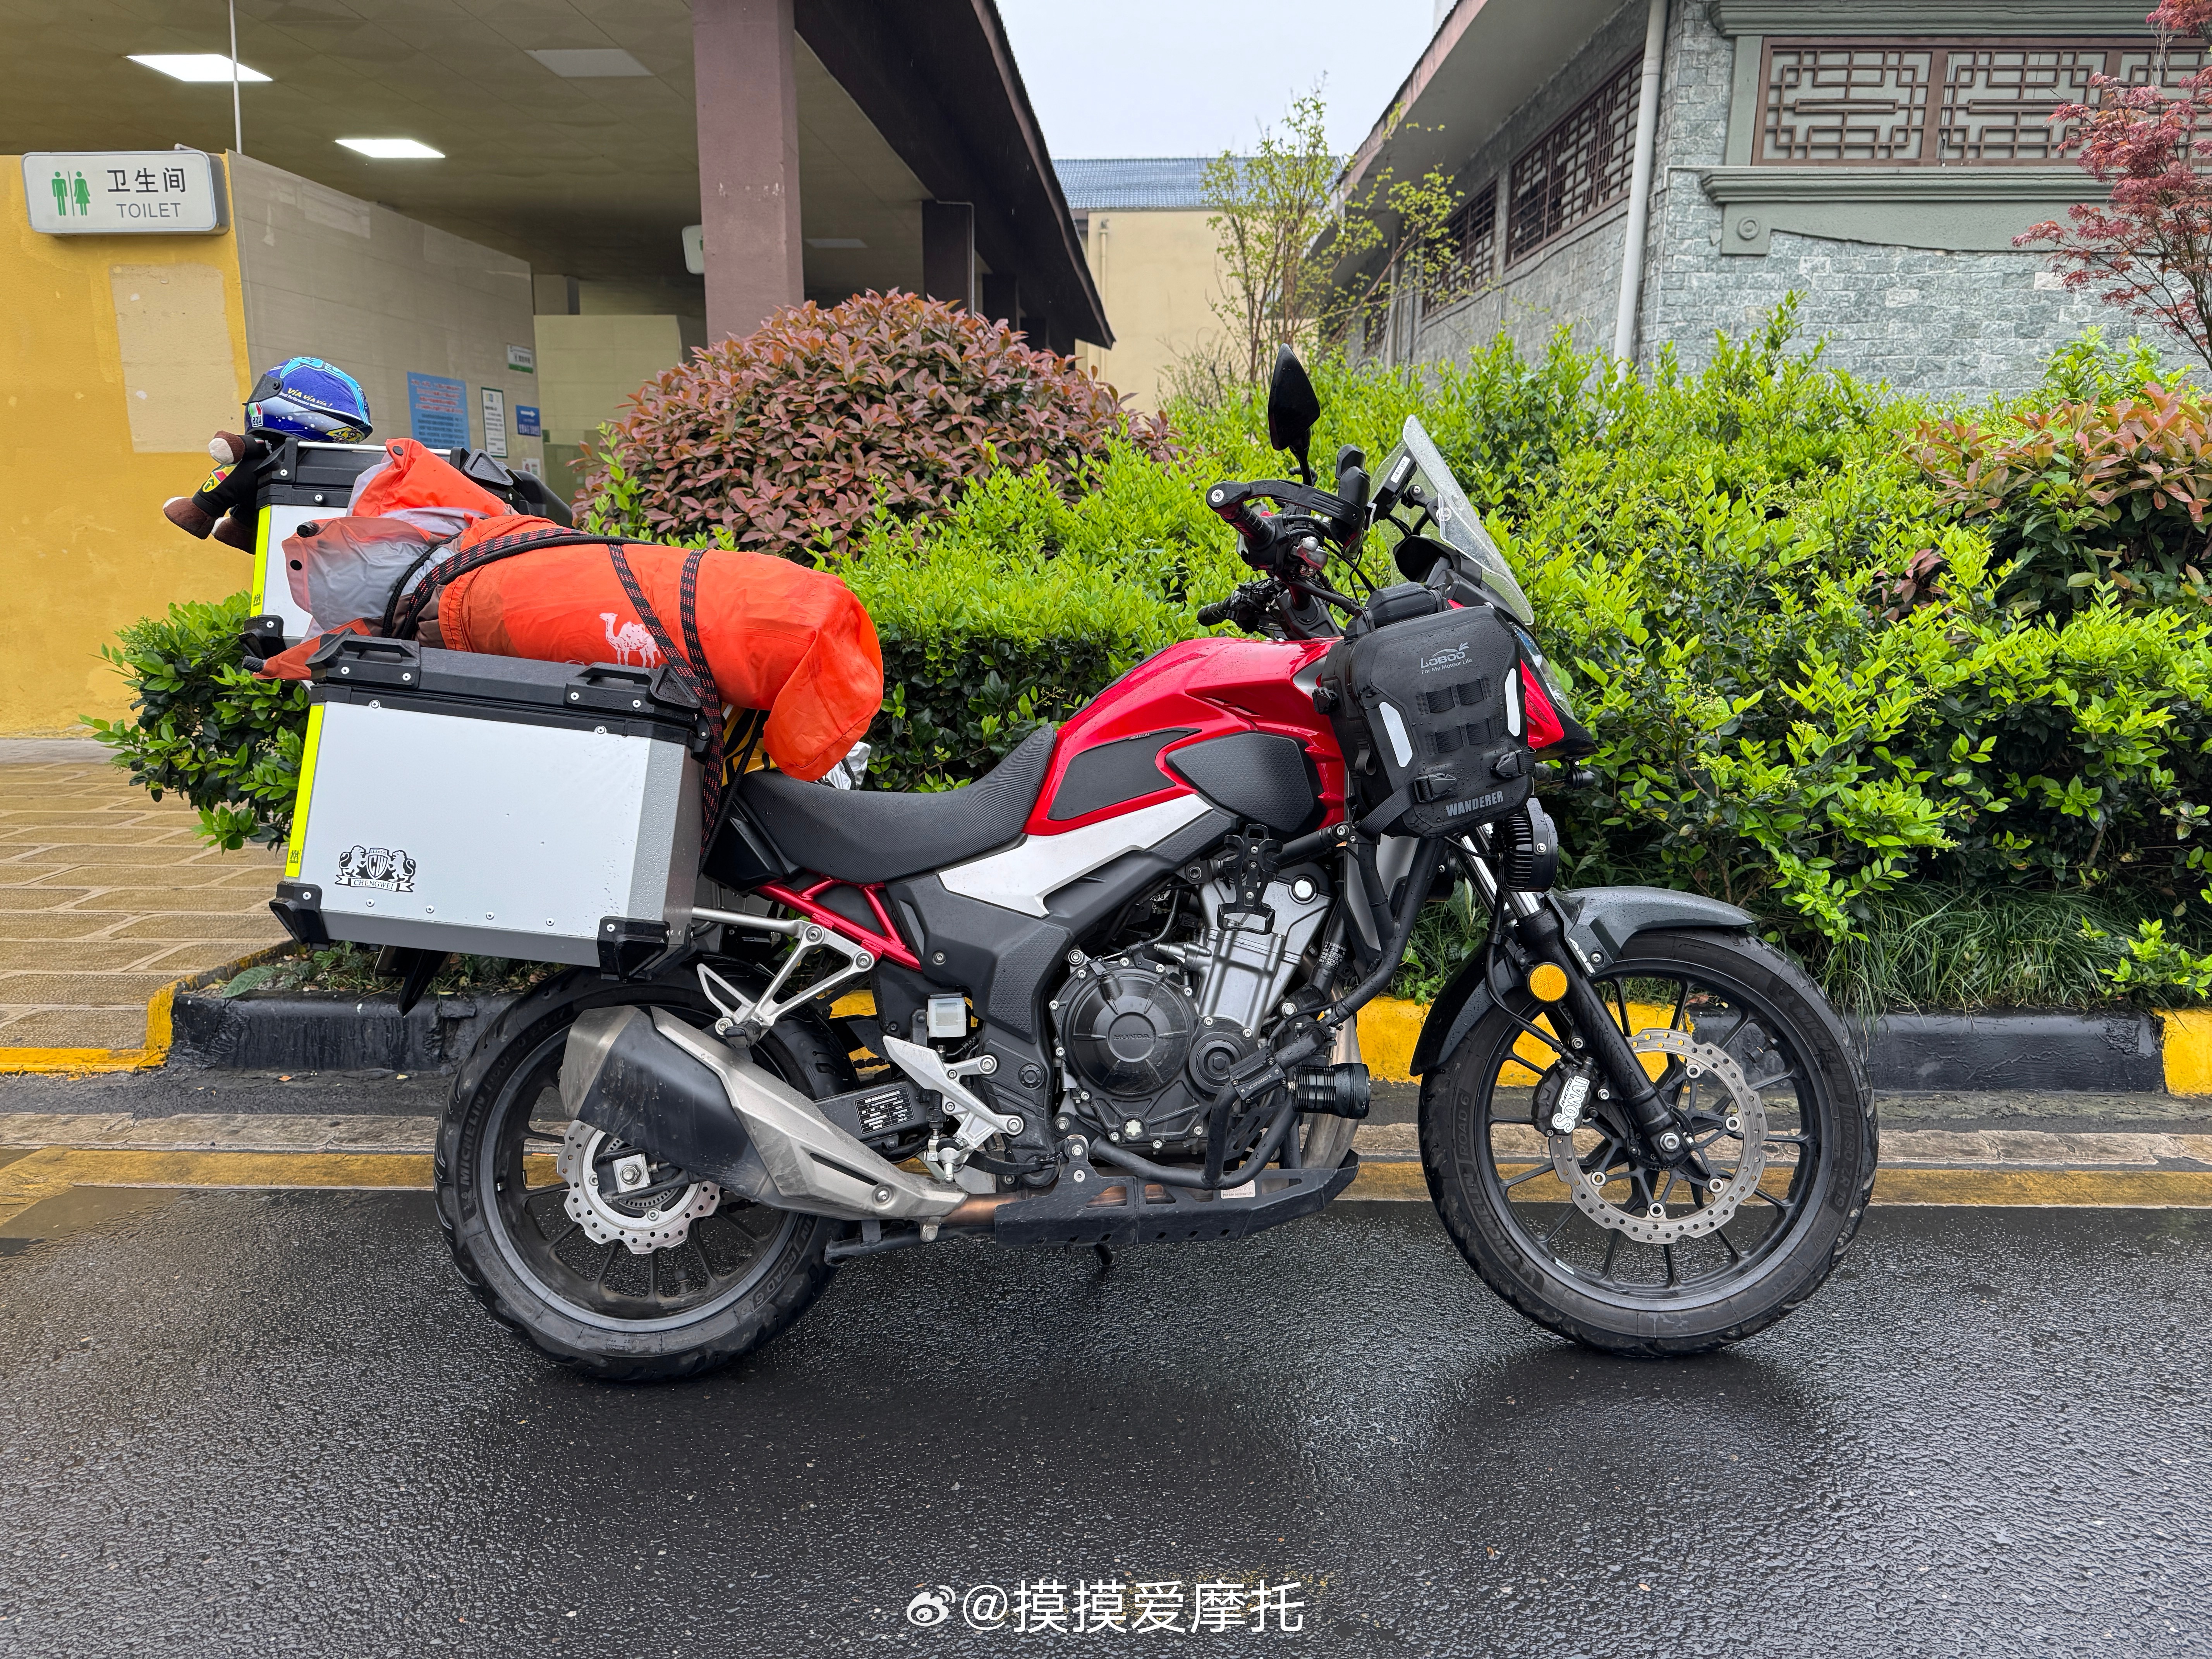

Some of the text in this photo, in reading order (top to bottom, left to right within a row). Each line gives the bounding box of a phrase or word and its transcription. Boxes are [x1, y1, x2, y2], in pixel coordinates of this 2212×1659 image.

[107, 167, 186, 193] 卫生间
[116, 203, 181, 218] TOILET
[1420, 651, 1465, 669] LOBOO
[1441, 661, 1462, 670] Motour
[1446, 790, 1504, 817] WANDERER
[354, 879, 394, 890] CHENGWEI
[1568, 937, 1596, 973] ABS
[1792, 1006, 1851, 1096] MICHELIN
[1458, 1095, 1470, 1156] ROAD 6
[1554, 1077, 1589, 1131] SONAI
[460, 1095, 487, 1186] MICHELIN
[1834, 1110, 1856, 1208] 110/80 ZR 19
[1463, 1172, 1518, 1262] MICHELIN
[756, 1250, 796, 1305] ROAD 6
